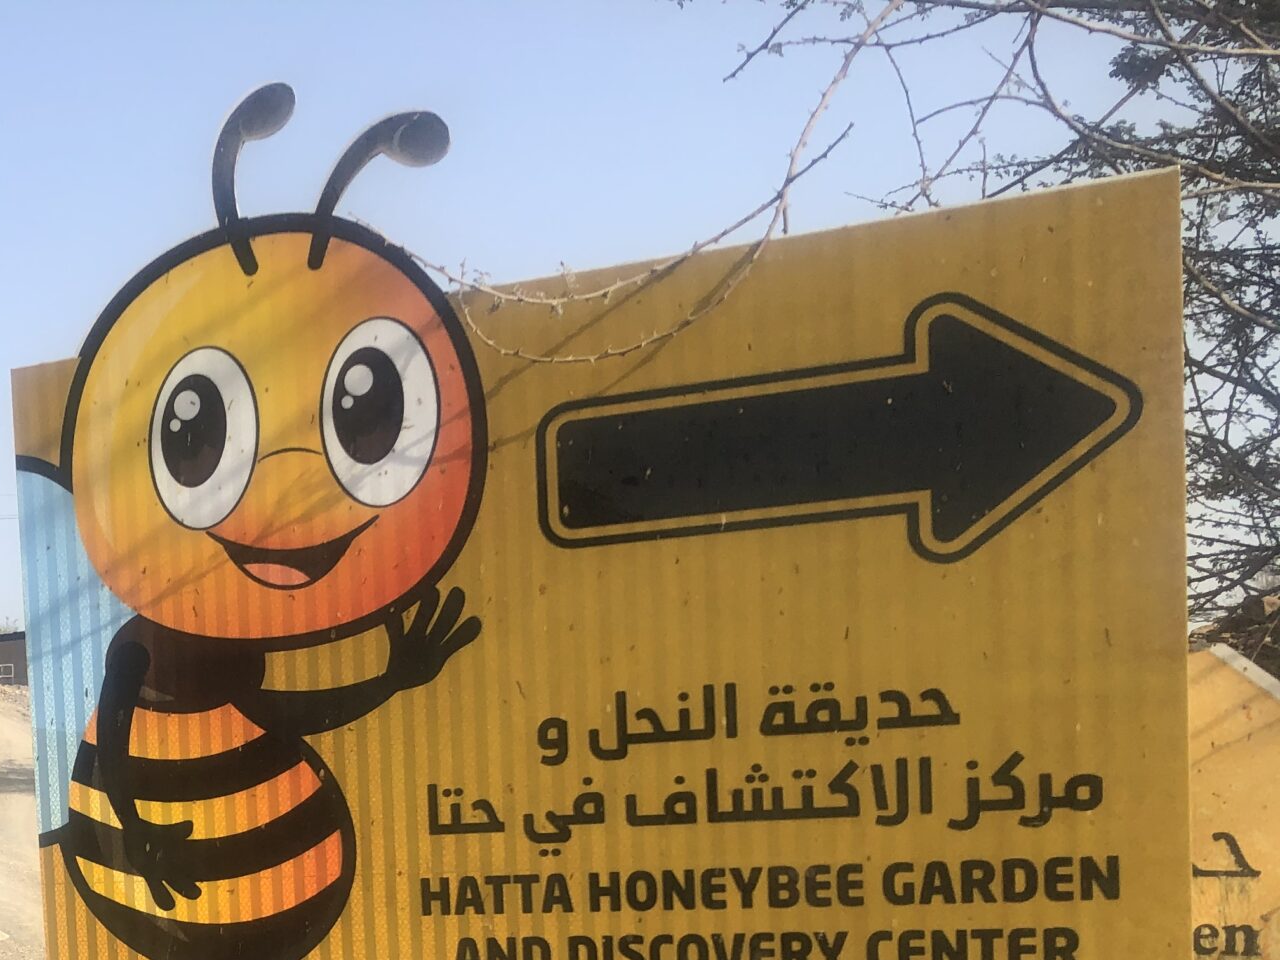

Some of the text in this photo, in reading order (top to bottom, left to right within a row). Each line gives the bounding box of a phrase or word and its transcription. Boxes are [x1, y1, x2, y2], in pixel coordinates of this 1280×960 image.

[537, 682, 961, 766] حديقة النحل و
[427, 751, 1104, 858] مركز الاكتشاف في حتا
[420, 856, 1120, 917] HATTA HONEYBEE GARDEN
